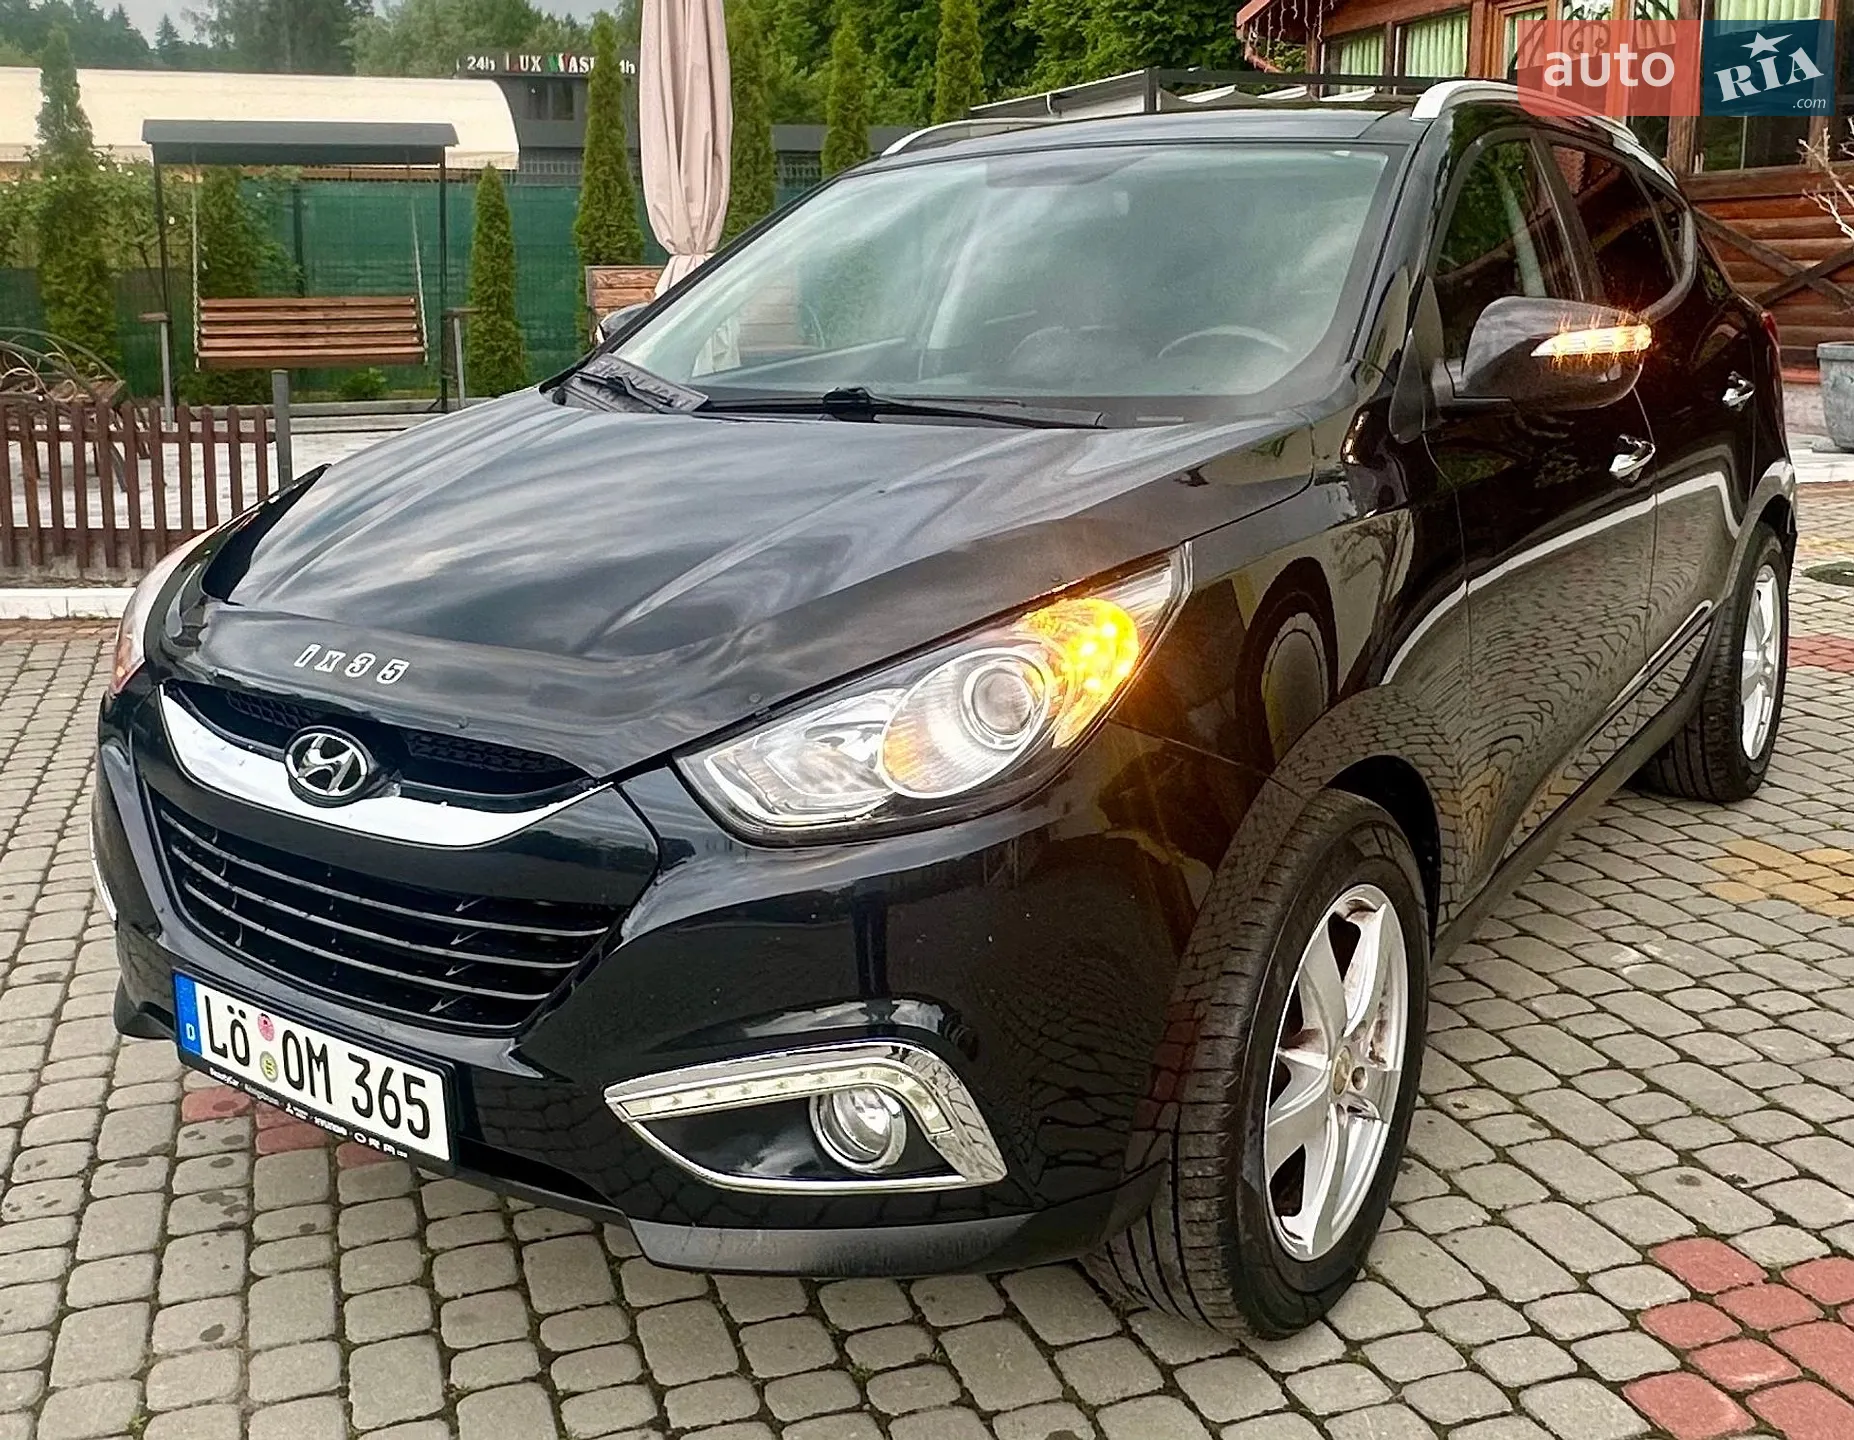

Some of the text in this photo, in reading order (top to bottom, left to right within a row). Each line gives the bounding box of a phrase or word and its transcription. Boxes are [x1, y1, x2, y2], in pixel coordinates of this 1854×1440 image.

[467, 55, 496, 71] 24h
[504, 51, 542, 72] LUX
[282, 1029, 333, 1105] OM
[347, 1052, 431, 1140] 365
